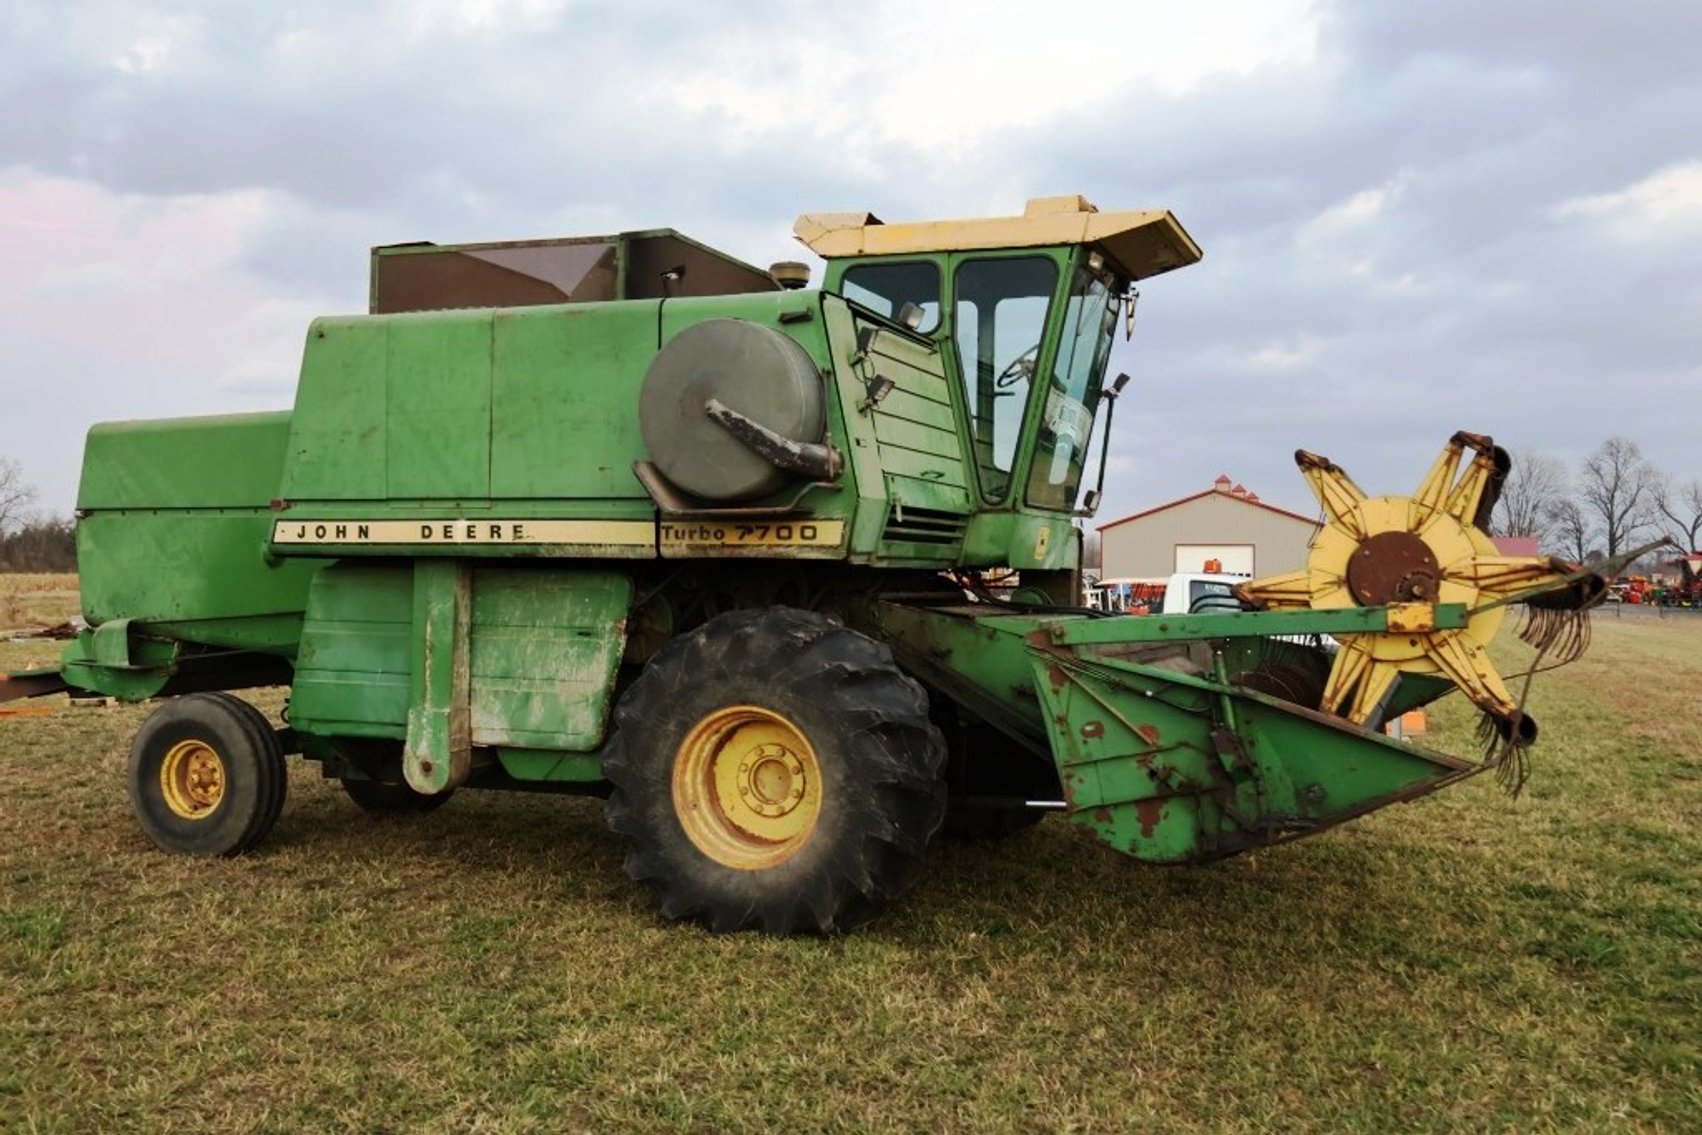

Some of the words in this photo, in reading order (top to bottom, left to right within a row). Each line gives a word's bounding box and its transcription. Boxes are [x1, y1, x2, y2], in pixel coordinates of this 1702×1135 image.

[297, 525, 370, 539] JOHN
[421, 525, 525, 540] DEERE
[661, 525, 726, 541] Turbo
[734, 525, 817, 541] 7700
